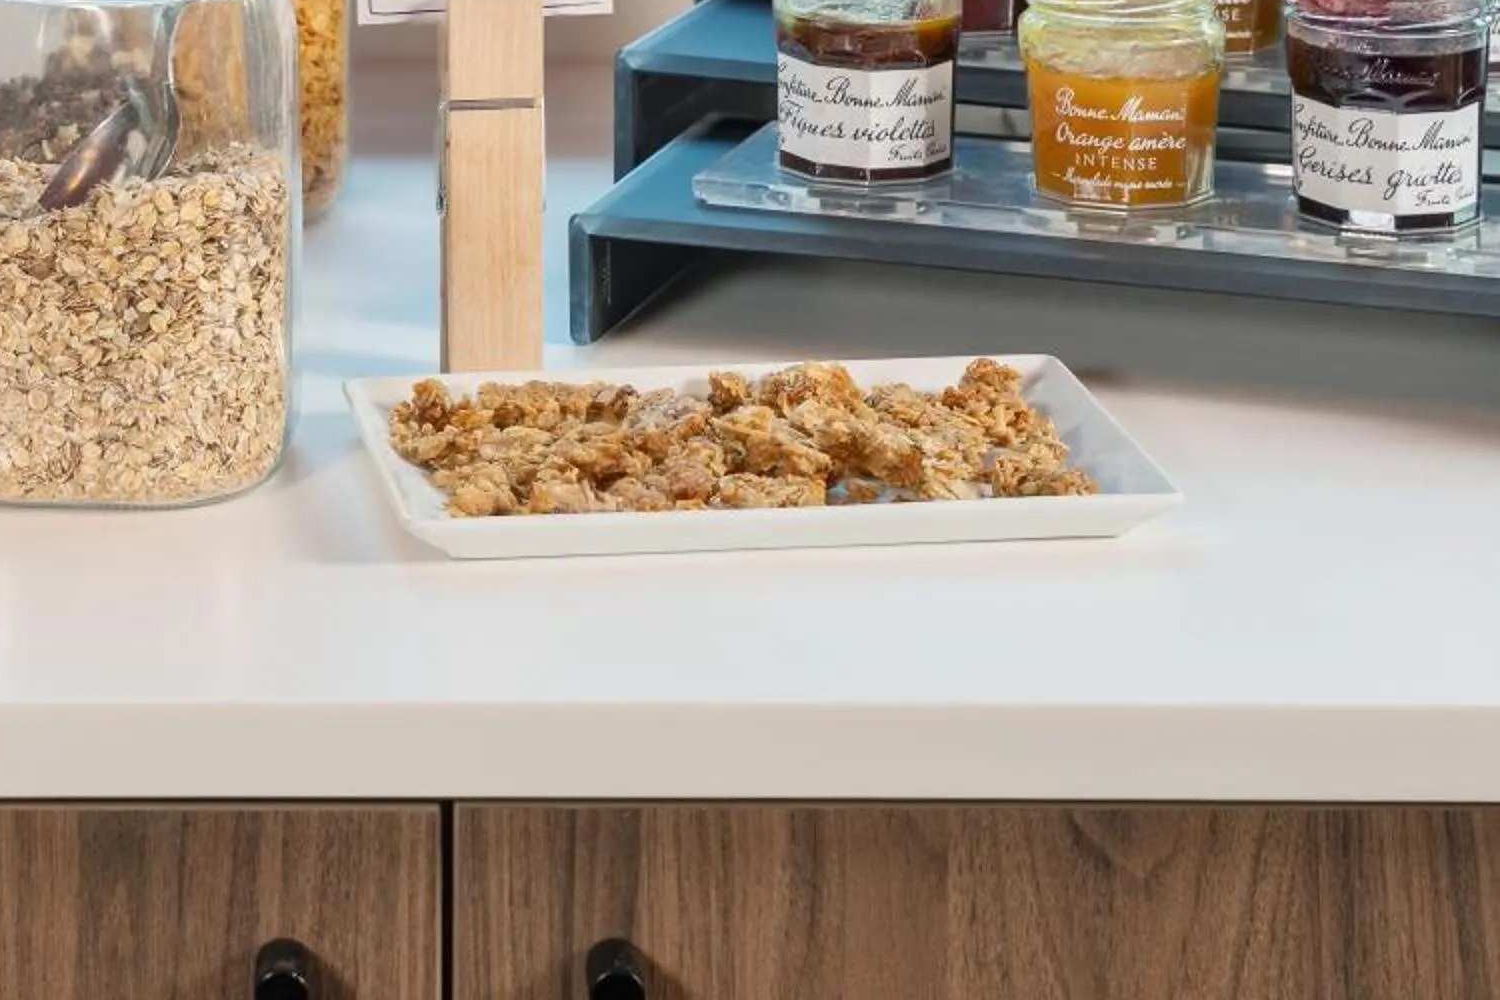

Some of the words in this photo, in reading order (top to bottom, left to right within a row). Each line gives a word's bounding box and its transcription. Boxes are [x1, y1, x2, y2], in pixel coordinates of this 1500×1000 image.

[824, 74, 882, 108] Bonne
[1055, 86, 1109, 120] Bonne
[1056, 121, 1125, 155] Orange
[1128, 131, 1187, 151] amère
[1346, 117, 1410, 151] Bonne
[1075, 153, 1158, 171] INTENSE
